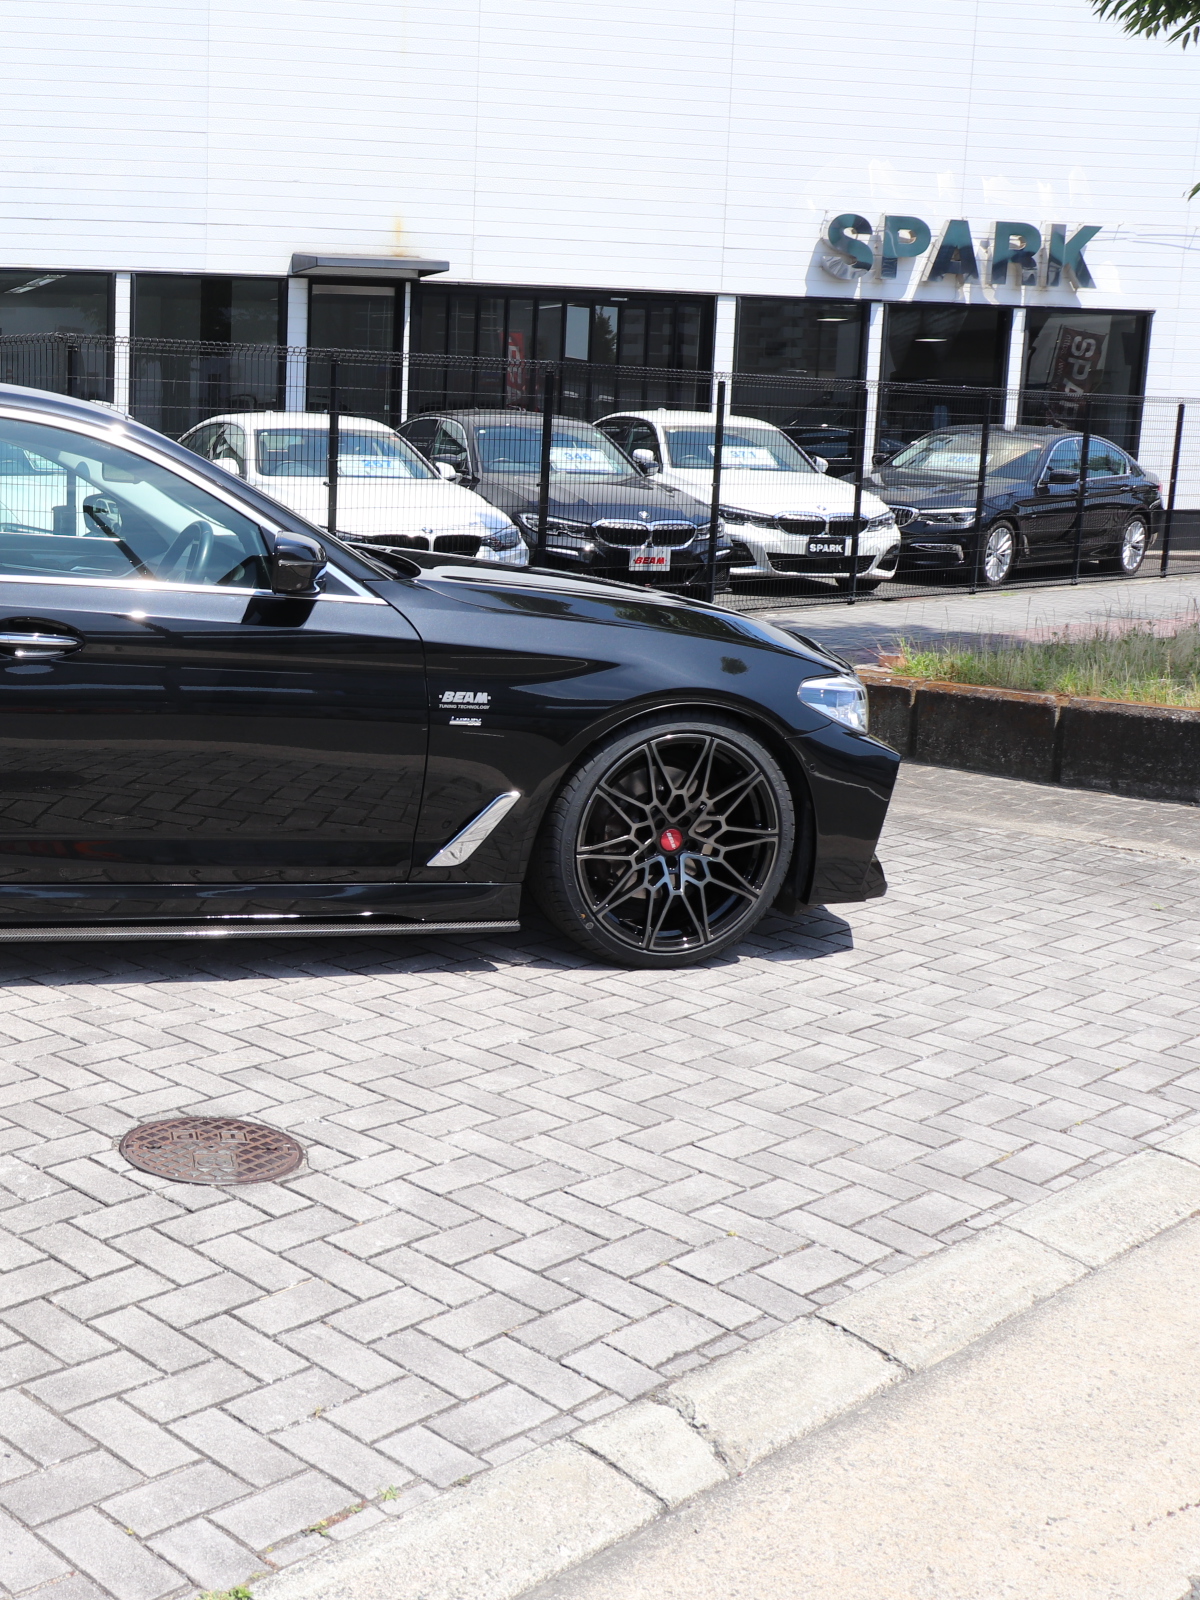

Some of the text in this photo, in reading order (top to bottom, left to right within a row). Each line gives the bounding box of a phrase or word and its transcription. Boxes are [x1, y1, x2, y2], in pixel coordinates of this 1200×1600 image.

[821, 213, 1103, 290] SPARK
[809, 543, 844, 553] SPARK
[634, 556, 665, 565] BEAM
[441, 690, 488, 704] BEAM
